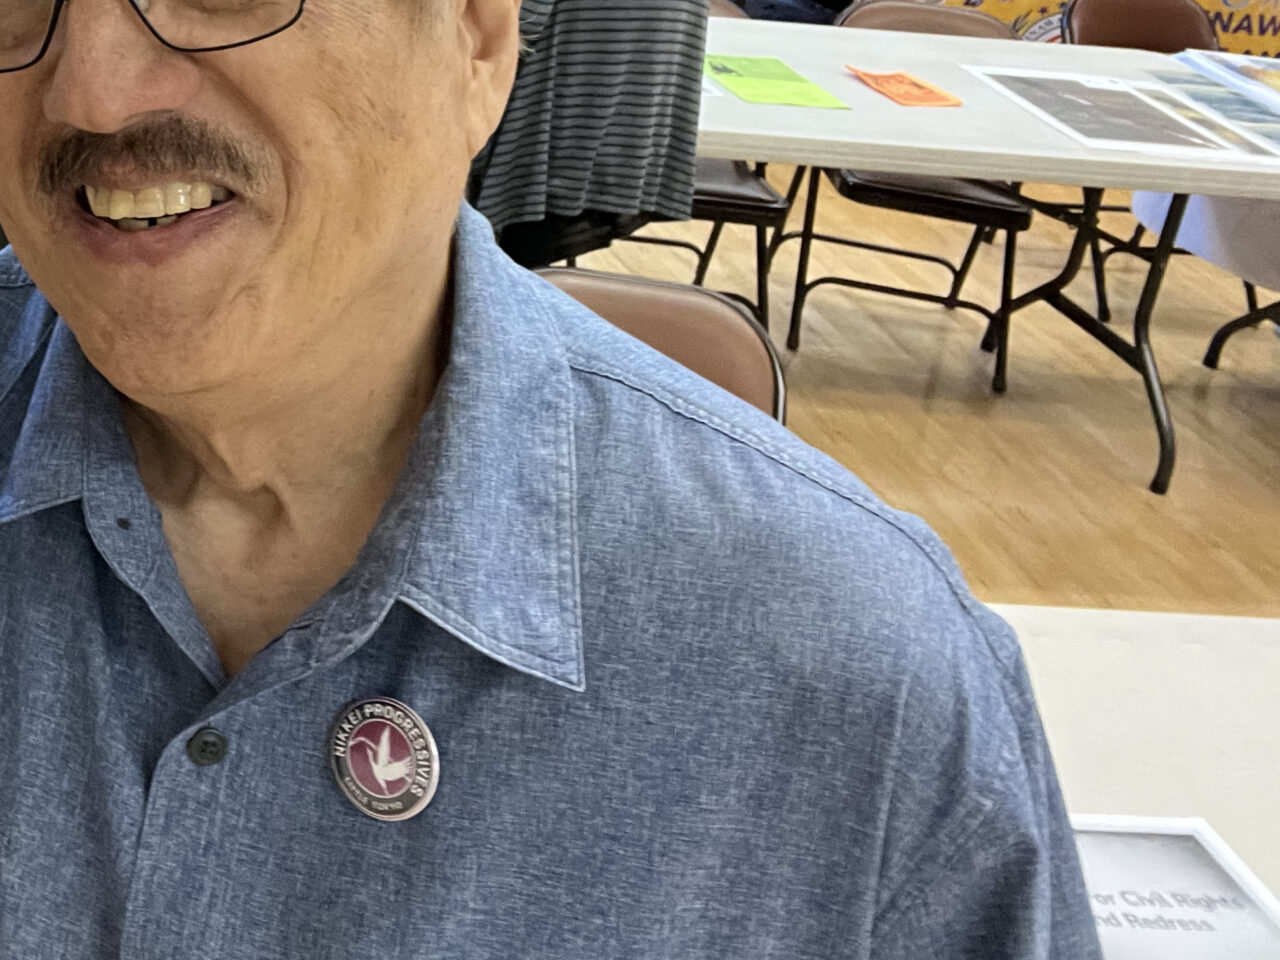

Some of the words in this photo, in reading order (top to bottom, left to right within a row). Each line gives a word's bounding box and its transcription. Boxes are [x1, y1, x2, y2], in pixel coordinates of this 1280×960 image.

[1209, 10, 1280, 37] NAW
[334, 709, 362, 758] NIKKEI
[363, 703, 432, 797] PROGRESSIVES
[1092, 893, 1117, 906] or
[1096, 912, 1122, 929] nd
